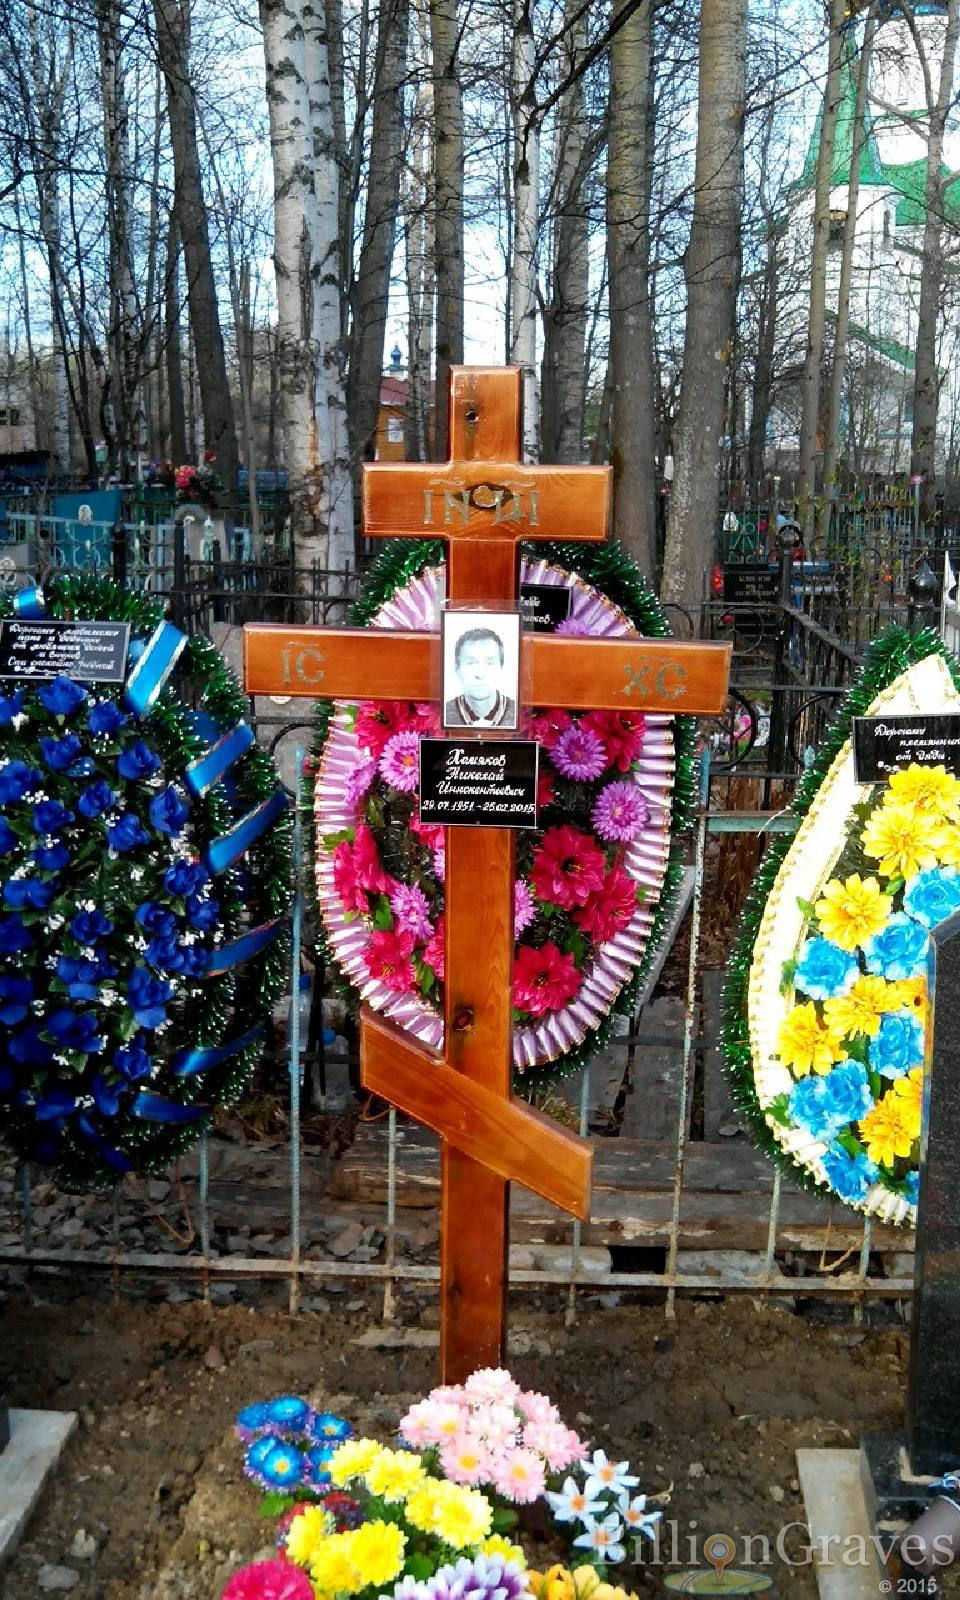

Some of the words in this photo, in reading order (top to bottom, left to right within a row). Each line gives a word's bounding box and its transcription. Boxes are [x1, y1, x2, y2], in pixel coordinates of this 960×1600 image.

[874, 723, 926, 741] Дорогому
[895, 750, 912, 761] от
[445, 766, 505, 781] Николай
